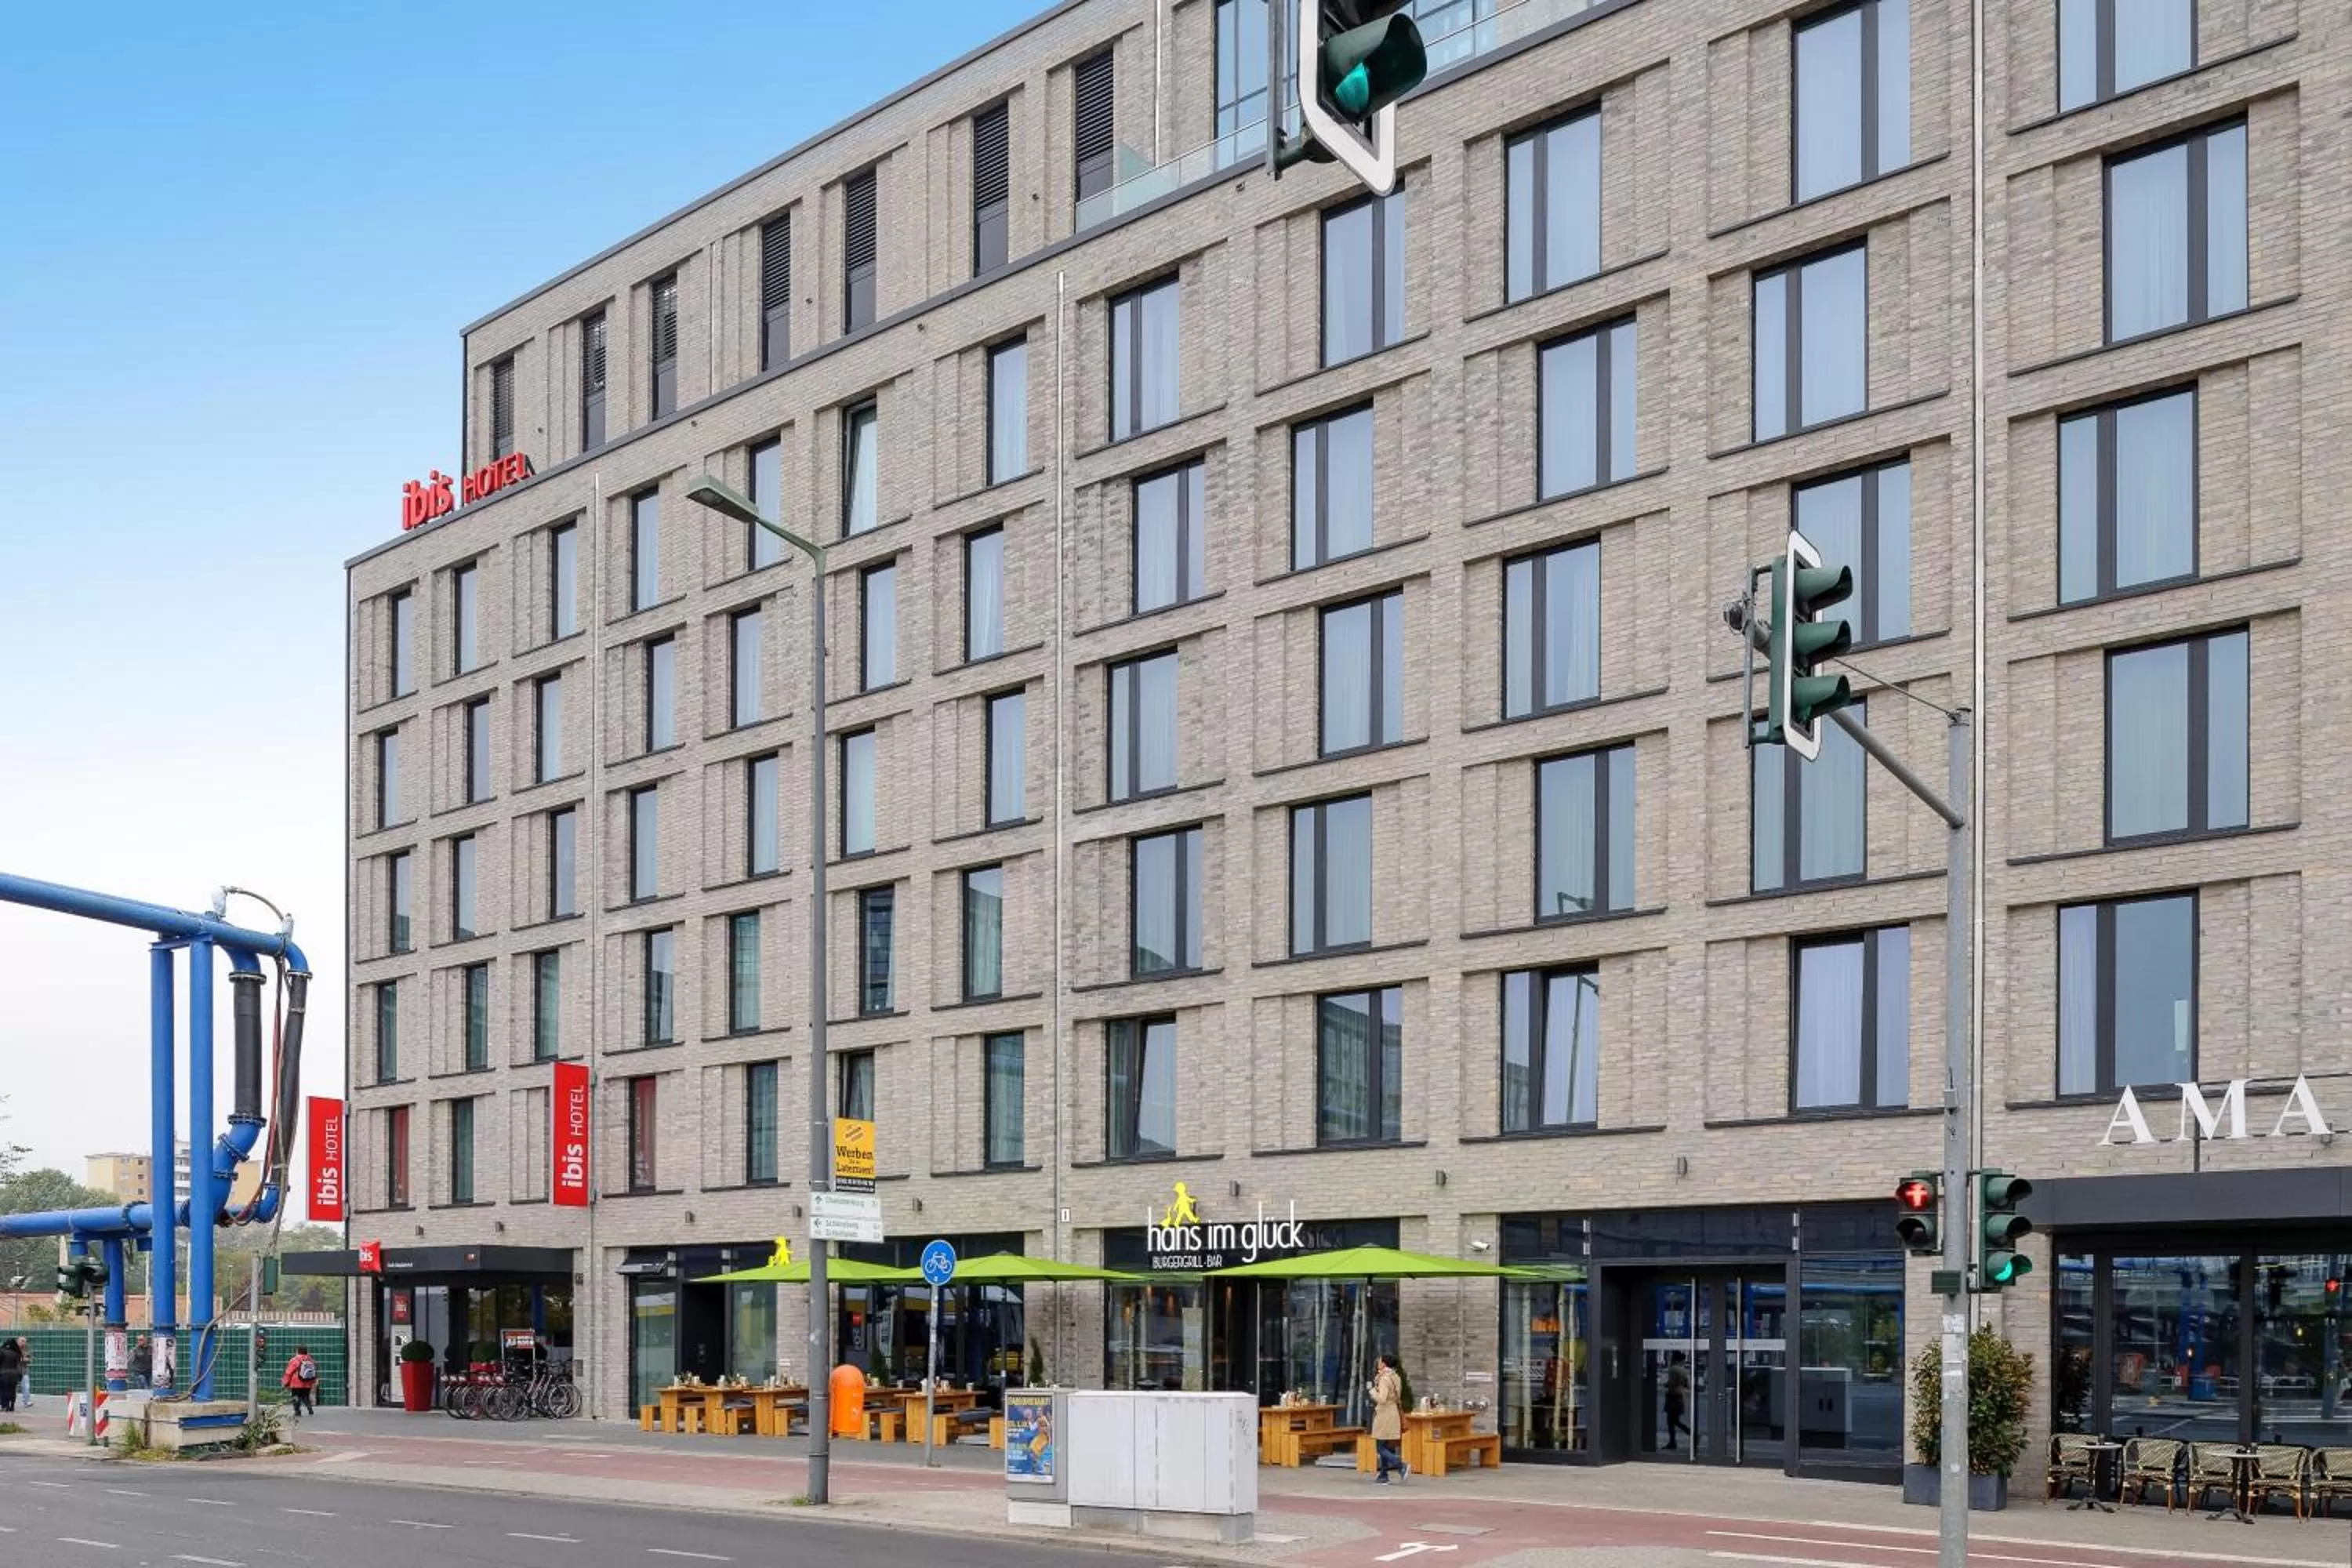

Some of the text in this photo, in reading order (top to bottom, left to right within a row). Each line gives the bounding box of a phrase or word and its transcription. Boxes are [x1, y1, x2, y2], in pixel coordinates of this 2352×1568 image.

[402, 452, 530, 531] ibis HOTEL
[561, 1085, 584, 1188] ibis HOTEL
[2096, 1073, 2333, 1145] AMA
[317, 1116, 338, 1205] ibis HOTEL
[1147, 1200, 1305, 1263] hans im glück
